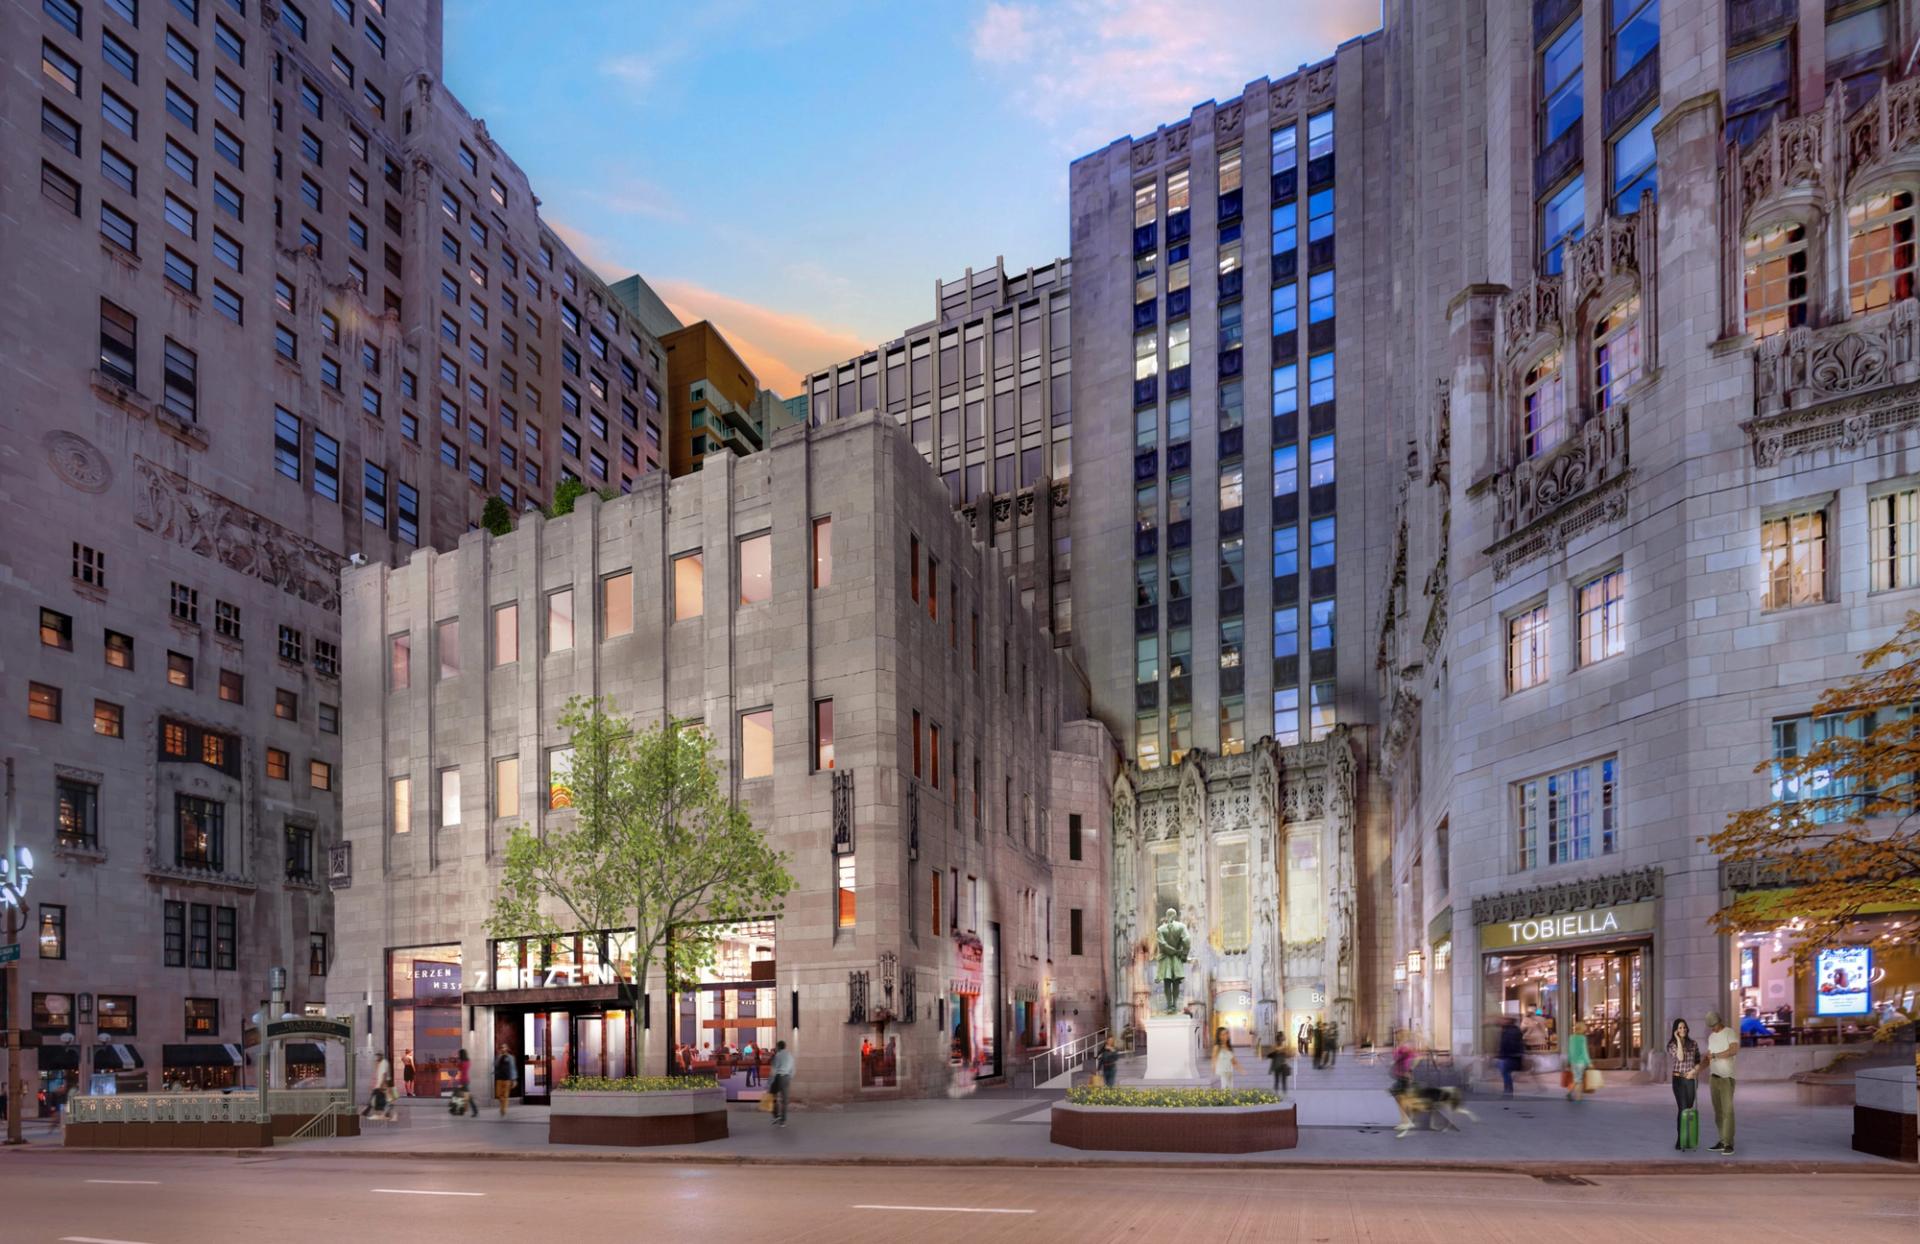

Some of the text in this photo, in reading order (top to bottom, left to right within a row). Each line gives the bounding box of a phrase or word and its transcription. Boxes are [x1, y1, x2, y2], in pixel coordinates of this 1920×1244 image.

[1508, 912, 1618, 942] TOBIELLA
[407, 968, 452, 979] ZERZEN
[474, 964, 615, 990] ZRZEN
